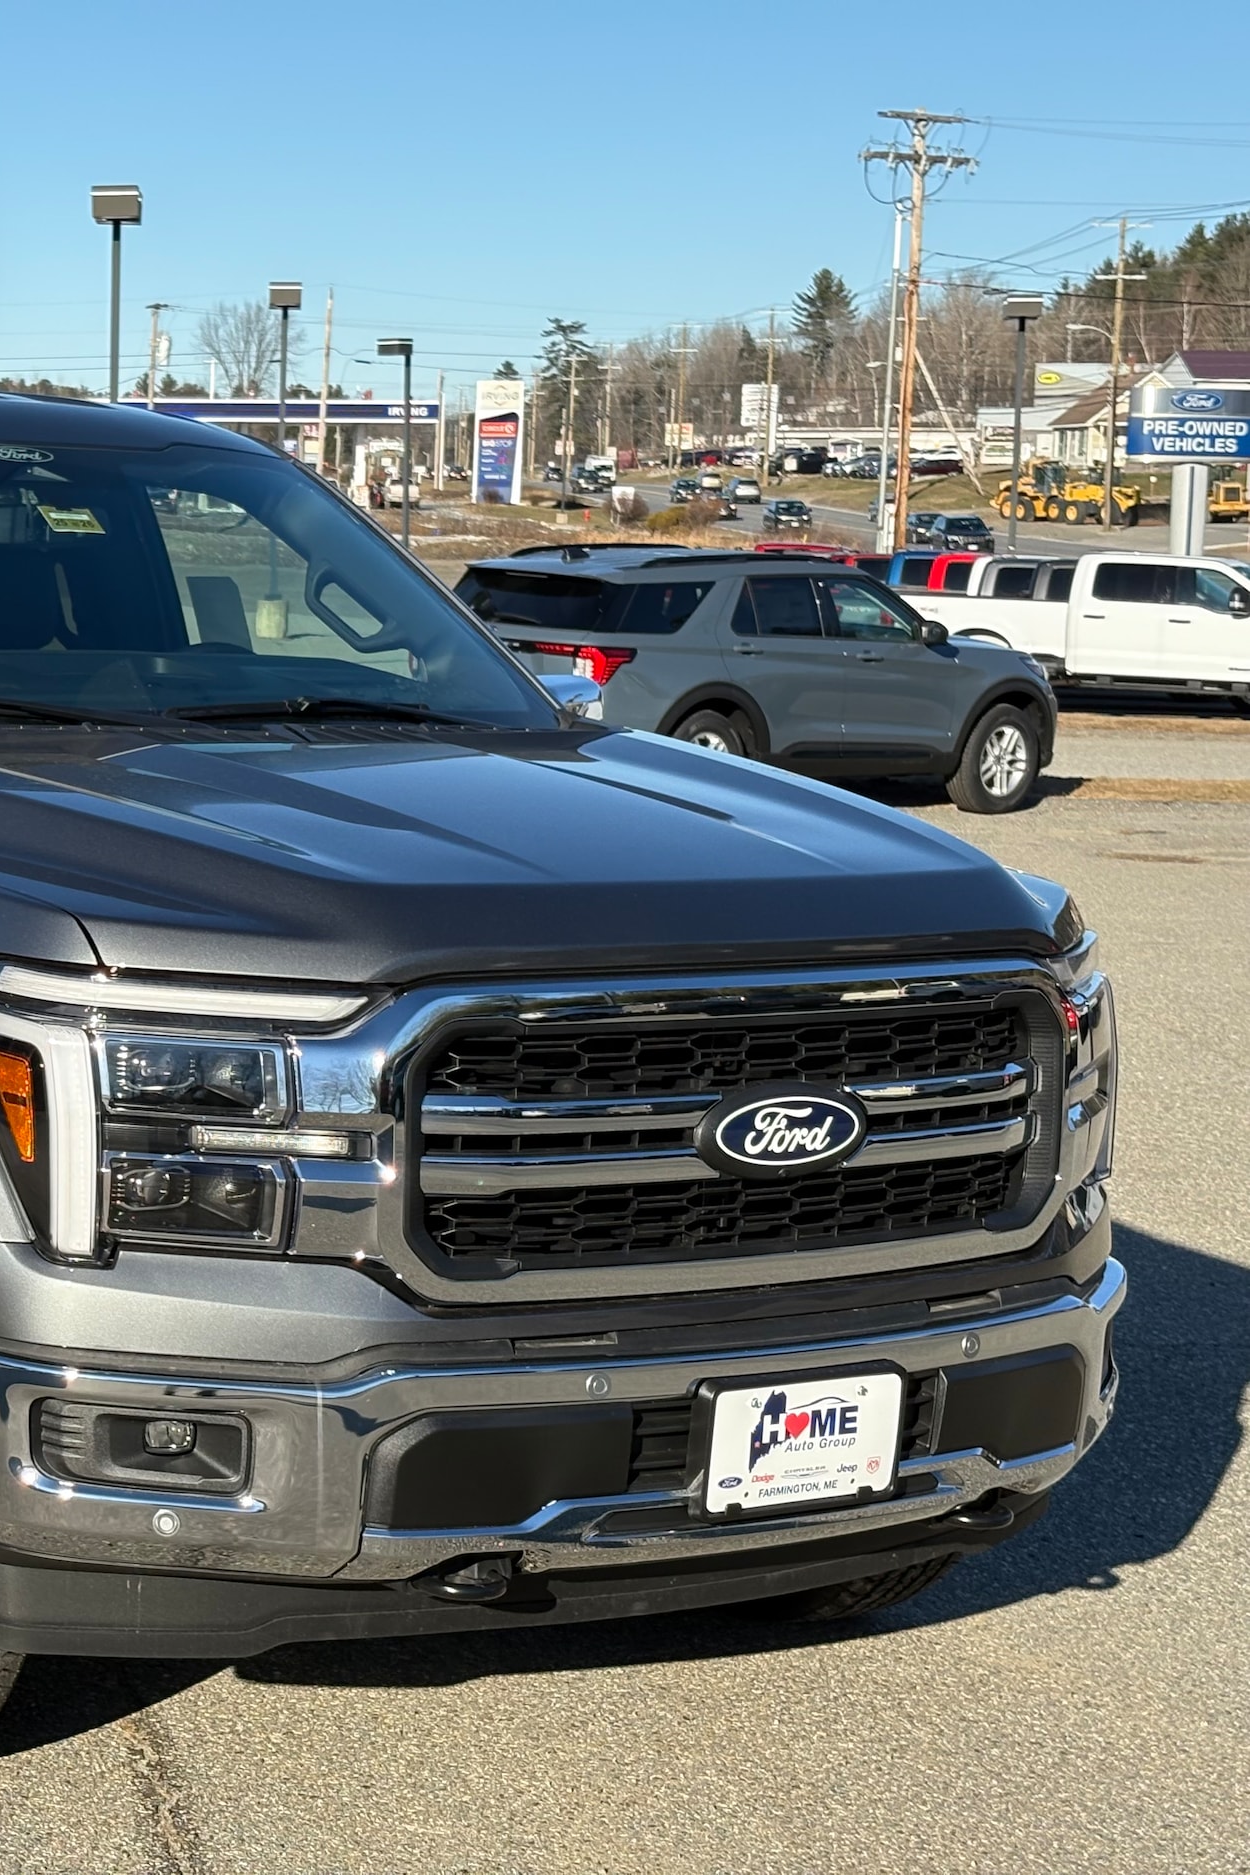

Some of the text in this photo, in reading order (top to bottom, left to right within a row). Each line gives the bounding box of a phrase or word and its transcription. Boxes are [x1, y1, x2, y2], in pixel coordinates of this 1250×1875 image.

[1183, 394, 1215, 408] Ford
[387, 406, 429, 417] IRVNG
[1142, 420, 1248, 437] PRE-OWNED
[1152, 437, 1238, 453] VEHICLES
[743, 1107, 834, 1155] Ford
[785, 1436, 856, 1453] Auto Group
[836, 1463, 858, 1473] Jeep
[751, 1474, 775, 1484] Dodge
[758, 1480, 839, 1498] FARMINGTON, ME
